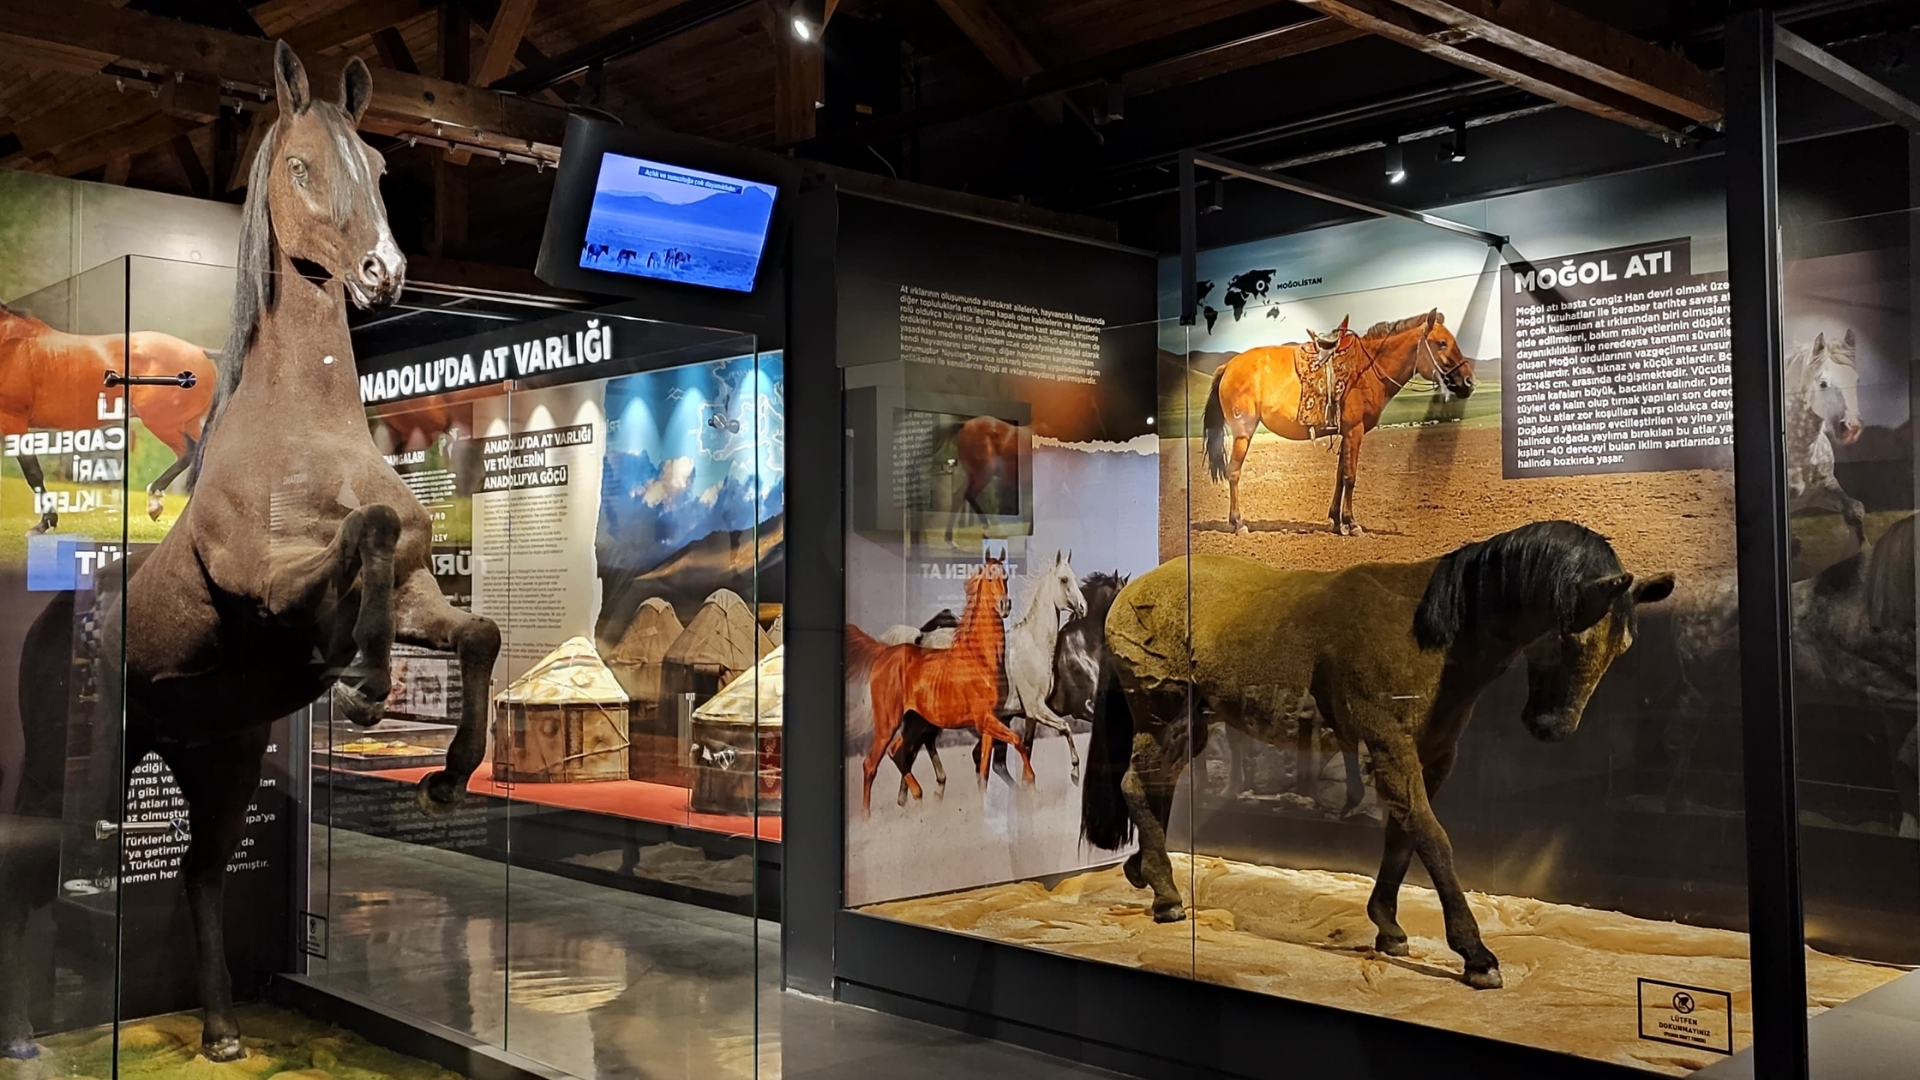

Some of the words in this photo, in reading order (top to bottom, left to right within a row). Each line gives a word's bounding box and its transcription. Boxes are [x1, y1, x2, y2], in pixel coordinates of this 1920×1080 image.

[1277, 277, 1322, 290] MOĞOLİSTAN
[1514, 259, 1617, 294] MOĞOL
[1623, 250, 1672, 279] ATI
[1516, 303, 1544, 316] Moğol
[1561, 298, 1586, 311] başta
[1589, 293, 1622, 307] Cengiz
[1625, 291, 1644, 301] Han
[1647, 287, 1672, 298] devri
[1675, 283, 1707, 295] olmak
[1516, 315, 1544, 327] Moğol
[1597, 307, 1608, 316] ile
[1611, 302, 1649, 314] beraber
[1653, 297, 1686, 309] tarihte
[1689, 295, 1717, 307] savaş
[1516, 337, 1535, 347] elde
[1589, 328, 1618, 339] bakım
[1621, 319, 1689, 337] maliyetlerinin
[1692, 315, 1723, 329] düşük
[1530, 325, 1546, 336] çok
[1548, 320, 1592, 333] kullanılan
[1595, 318, 1604, 327] at
[1607, 312, 1659, 326] ırklarından
[1662, 310, 1679, 320] biri
[1516, 343, 1581, 360] dayanıklılıkları
[1584, 342, 1595, 351] ile
[1598, 336, 1647, 351] neredeyse
[1651, 331, 1688, 344] tamamı
[1516, 358, 1546, 371] oluşan
[1549, 355, 1577, 368] Moğol
[1580, 349, 1631, 363] ordularının
[1634, 342, 1697, 359] vazgeçilmez
[360, 354, 475, 402] NADOLU'DA
[479, 347, 509, 382] AT
[513, 319, 612, 376] VARLIĞI
[1516, 367, 1569, 382] olmuşlardır.
[1572, 364, 1594, 376] Kısa,
[1597, 361, 1625, 372] tıknaz
[1643, 356, 1673, 369] küçük
[1676, 352, 1715, 364] atlardır.
[1517, 380, 1550, 391] 122-145
[1572, 374, 1611, 386] arasında
[1614, 366, 1687, 383] değişmektedir.
[1517, 391, 1545, 402] oranla
[1548, 388, 1581, 399] kafaları
[1584, 385, 1615, 397] büyük,
[1618, 380, 1663, 393] bacakları
[1517, 402, 1546, 414] tüyleri
[1548, 401, 1560, 410] de
[1587, 397, 1608, 408] olup
[1611, 394, 1639, 405] tırnak
[1642, 390, 1678, 403] yapıları
[1517, 414, 1536, 424] olan
[1539, 413, 1551, 422] bu
[1553, 411, 1574, 421] atlar
[1595, 406, 1637, 419] koşullara
[1641, 403, 1664, 415] karşı
[1667, 400, 1707, 413] oldukça
[1518, 424, 1558, 436] Doğadan
[1561, 420, 1605, 433] yakalanıp
[1608, 415, 1672, 429] evcilleştirilen
[1690, 412, 1712, 423] yine
[484, 437, 540, 455] ANADOLU'DA
[541, 435, 553, 448] AT
[554, 426, 592, 445] VARLIĞI
[1517, 435, 1550, 446] halinde
[1553, 432, 1588, 444] doğada
[1591, 429, 1627, 442] yaylıma
[1630, 426, 1673, 437] bırakılan
[1676, 424, 1689, 434] bu
[1692, 422, 1716, 432] atlar
[1518, 447, 1544, 458] kışları
[1547, 445, 1563, 454] -40
[1566, 442, 1605, 455] dereceyi
[1608, 440, 1635, 450] bulan
[1638, 439, 1661, 448] iklim
[1665, 435, 1720, 448] şartlarında
[484, 459, 495, 472] VE
[496, 450, 545, 471] TÜRKLERİN
[1518, 457, 1551, 467] halinde
[1553, 454, 1594, 465] bozkırda
[1596, 455, 1623, 464] yaşar.
[484, 473, 539, 490] ANADOLU'YA
[540, 468, 567, 487] GÖÇÜ
[266, 744, 278, 753] at
[161, 775, 174, 784] ve
[138, 786, 159, 799] gibi
[140, 799, 168, 809] atları
[172, 797, 184, 806] ile
[129, 858, 167, 871] Türkün
[160, 870, 178, 880] her
[1658, 1022, 1711, 1037] DOKUNMAYINIZ
[1670, 1014, 1698, 1026] LÜTFEN
